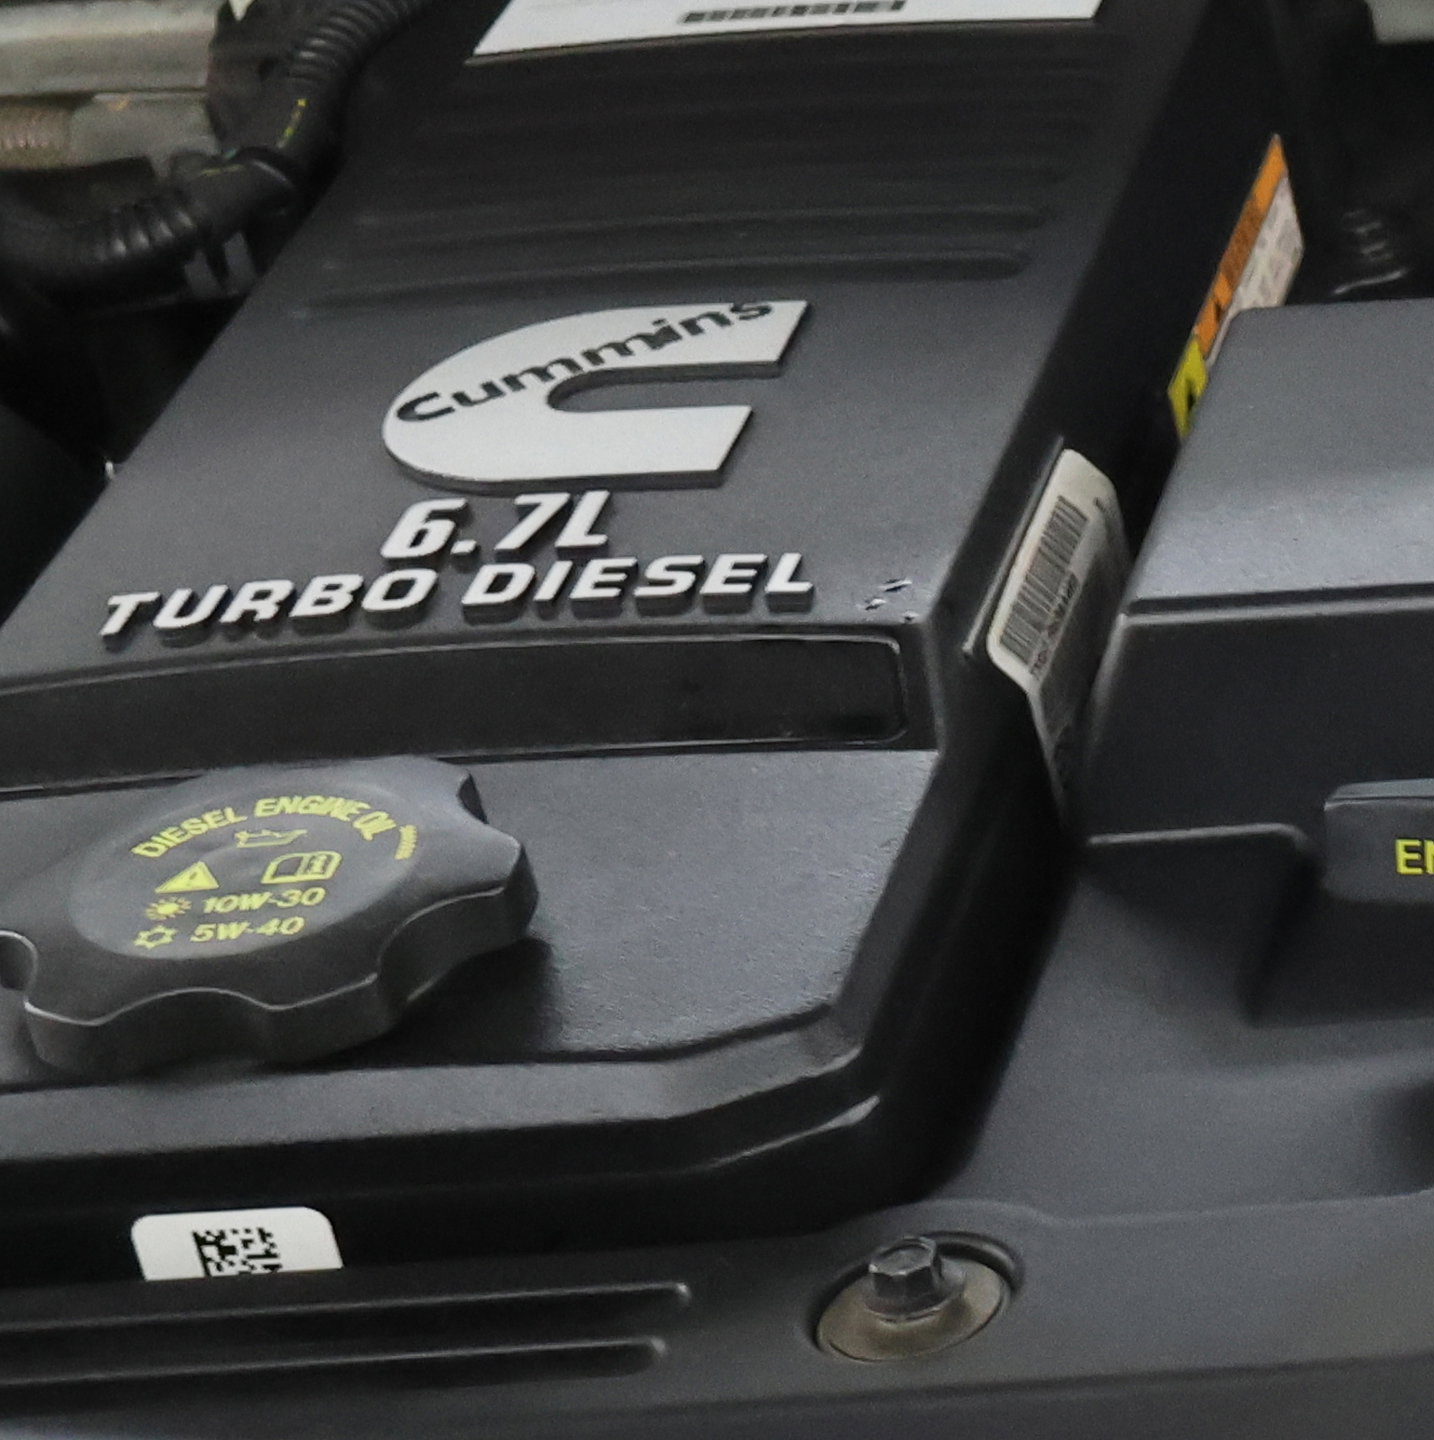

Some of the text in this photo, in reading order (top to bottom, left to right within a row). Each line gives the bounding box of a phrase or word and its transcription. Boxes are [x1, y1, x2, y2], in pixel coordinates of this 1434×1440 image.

[396, 300, 774, 422] Cummins
[380, 490, 612, 560] 6.7L
[101, 553, 814, 637] TURBO DIESEL
[131, 806, 248, 858] DIESEL
[254, 795, 371, 822] ENGINE
[353, 809, 397, 842] OIL
[189, 916, 306, 943] 5W-40
[203, 887, 327, 914] 10W-30
